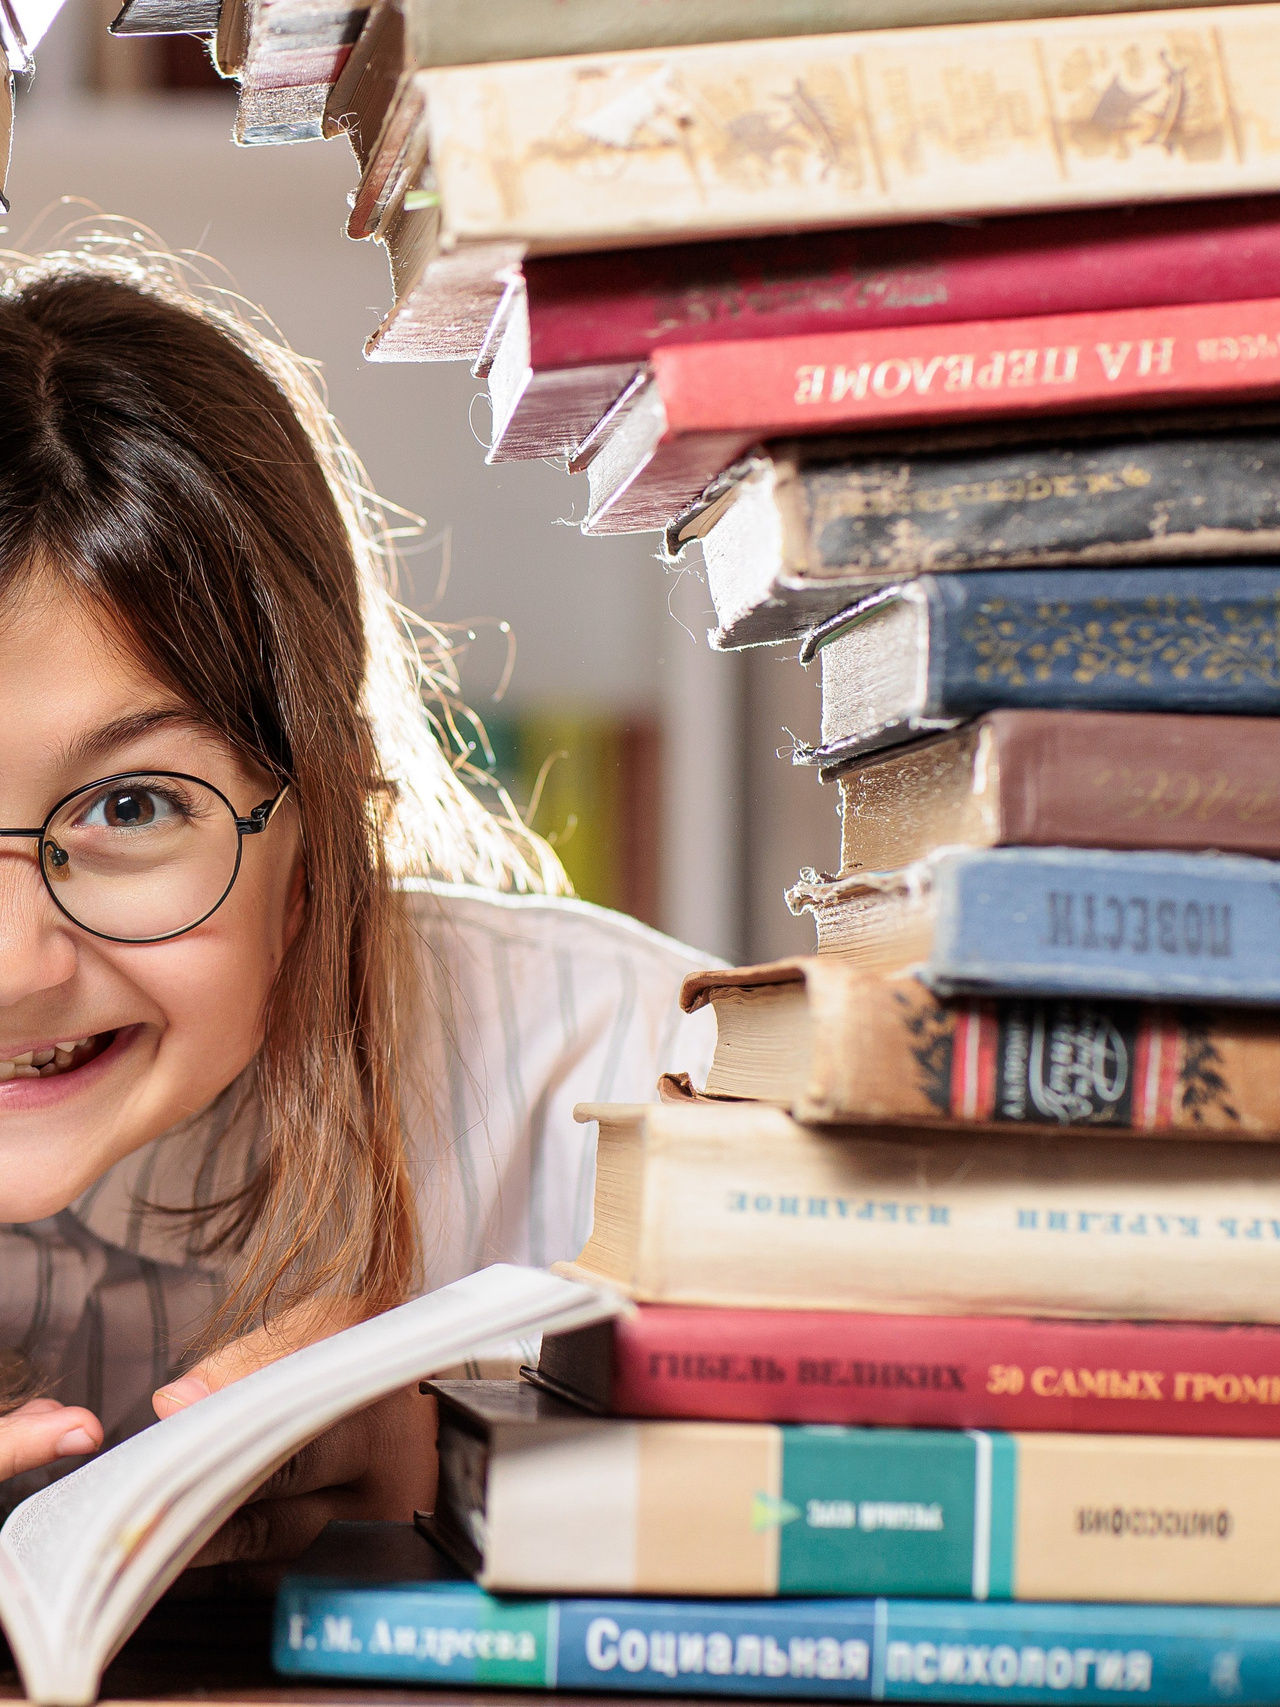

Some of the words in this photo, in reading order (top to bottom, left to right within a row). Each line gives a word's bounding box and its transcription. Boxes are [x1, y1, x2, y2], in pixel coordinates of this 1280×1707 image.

[794, 345, 1080, 405] ПЕРЕЛОМЕ
[1098, 336, 1176, 381] НА
[1040, 890, 1232, 955] ПОВЕСТИ
[728, 1192, 952, 1227] ИЗБРАННОЕ
[1016, 1207, 1200, 1238] КАРЕЛИН
[648, 1350, 786, 1385] ГИБЕЛЬ
[796, 1357, 968, 1392] ВЕЛИКИХ
[985, 1365, 1025, 1396] 50
[1030, 1367, 1165, 1402] САМЫХ
[806, 1500, 852, 1530] КУРС
[1075, 1506, 1234, 1542] ФИЛОСОФИЯ
[288, 1616, 317, 1652] Г.
[321, 1618, 364, 1655] М.
[368, 1618, 538, 1664] Андреева
[585, 1618, 870, 1682] Социальная
[886, 1644, 1154, 1692] психология
